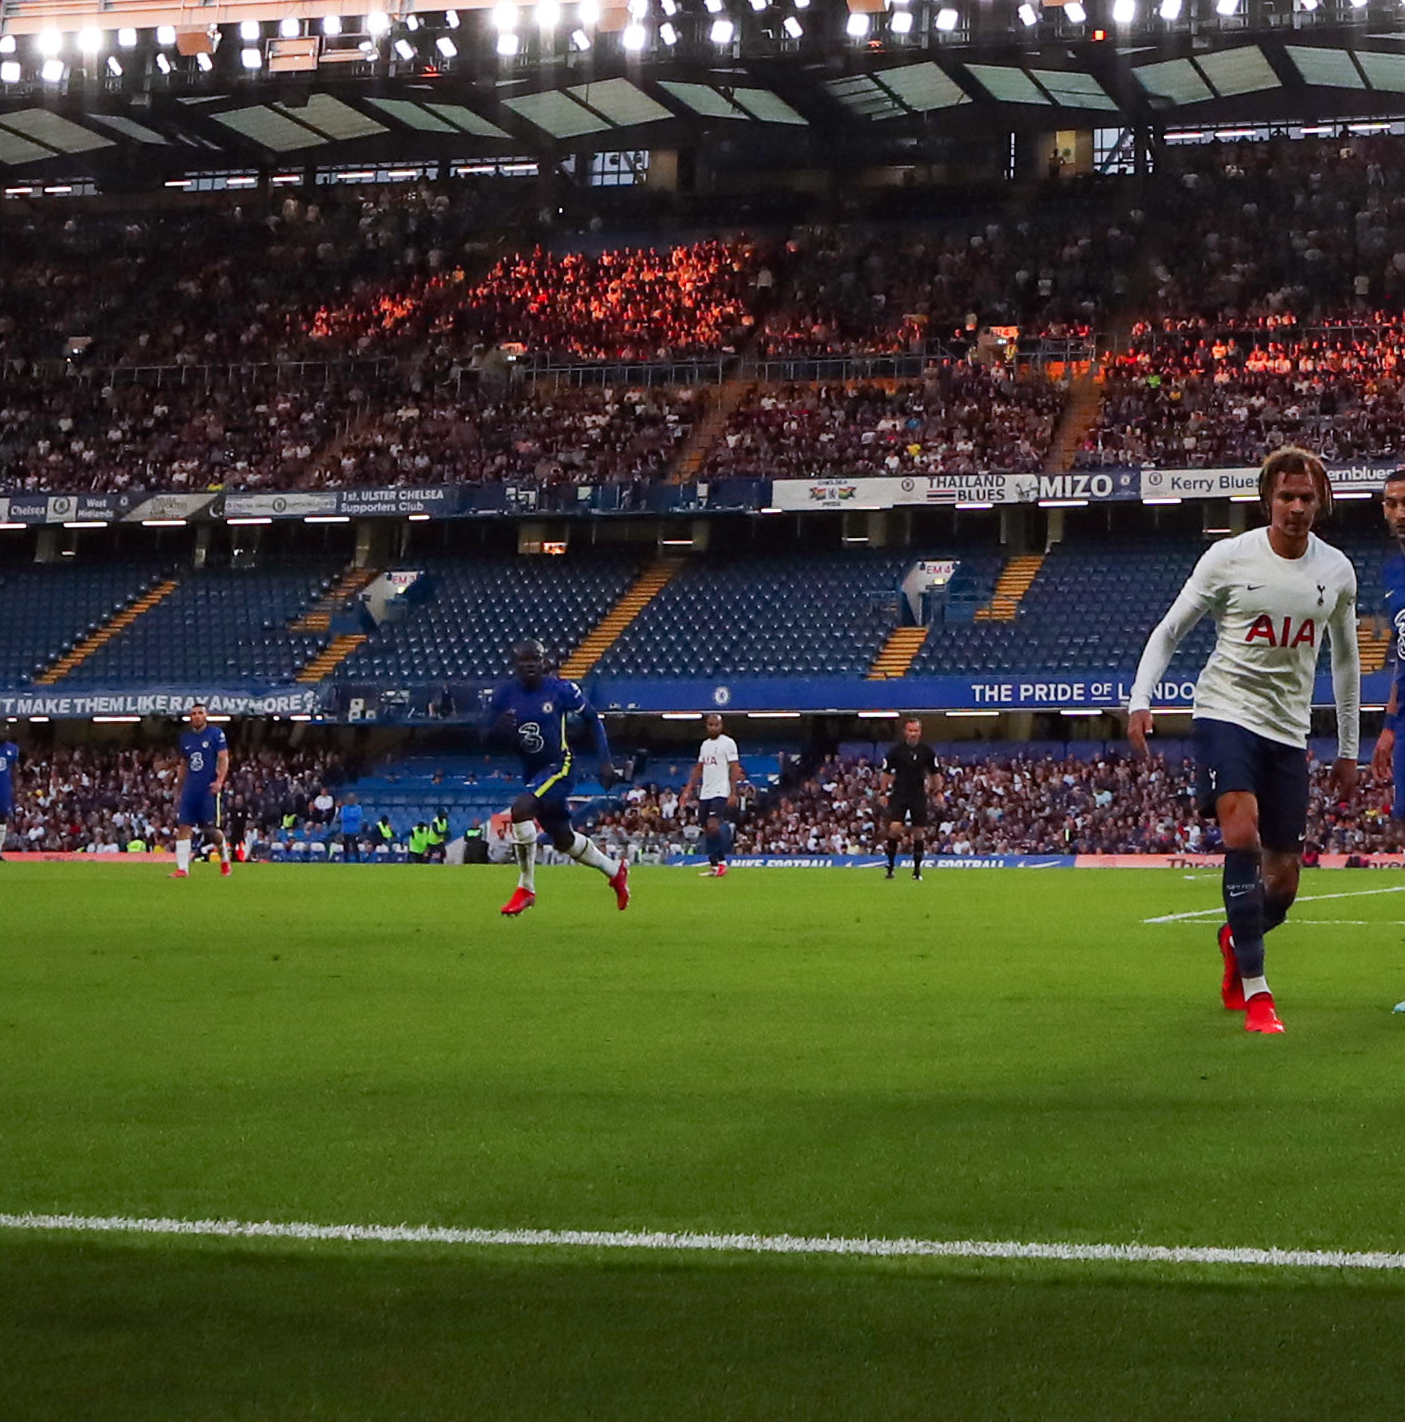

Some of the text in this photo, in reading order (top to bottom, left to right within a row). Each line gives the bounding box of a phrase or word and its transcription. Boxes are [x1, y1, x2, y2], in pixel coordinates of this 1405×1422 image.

[927, 474, 1006, 489] THAILAND
[1038, 474, 1114, 499] MIZO
[1171, 474, 1260, 492] Kerry Blues
[361, 489, 396, 501] ULSTER
[398, 488, 445, 500] CHELSEA
[957, 488, 1005, 502] BLUES
[10, 504, 46, 517] Chelsea
[340, 501, 395, 514] Supporters
[398, 500, 425, 511] Club
[927, 564, 952, 575] EM 4
[392, 575, 407, 584] EM
[1244, 614, 1315, 649] AIA
[971, 681, 1195, 702] THE PRIDE OF LNDO
[16, 698, 74, 714] MAKE
[75, 697, 125, 713] THEM
[126, 695, 168, 712] LIKE
[168, 695, 211, 711] RAY
[209, 694, 304, 714] ANYMORE
[730, 859, 833, 867] NIKE FOOTBALL
